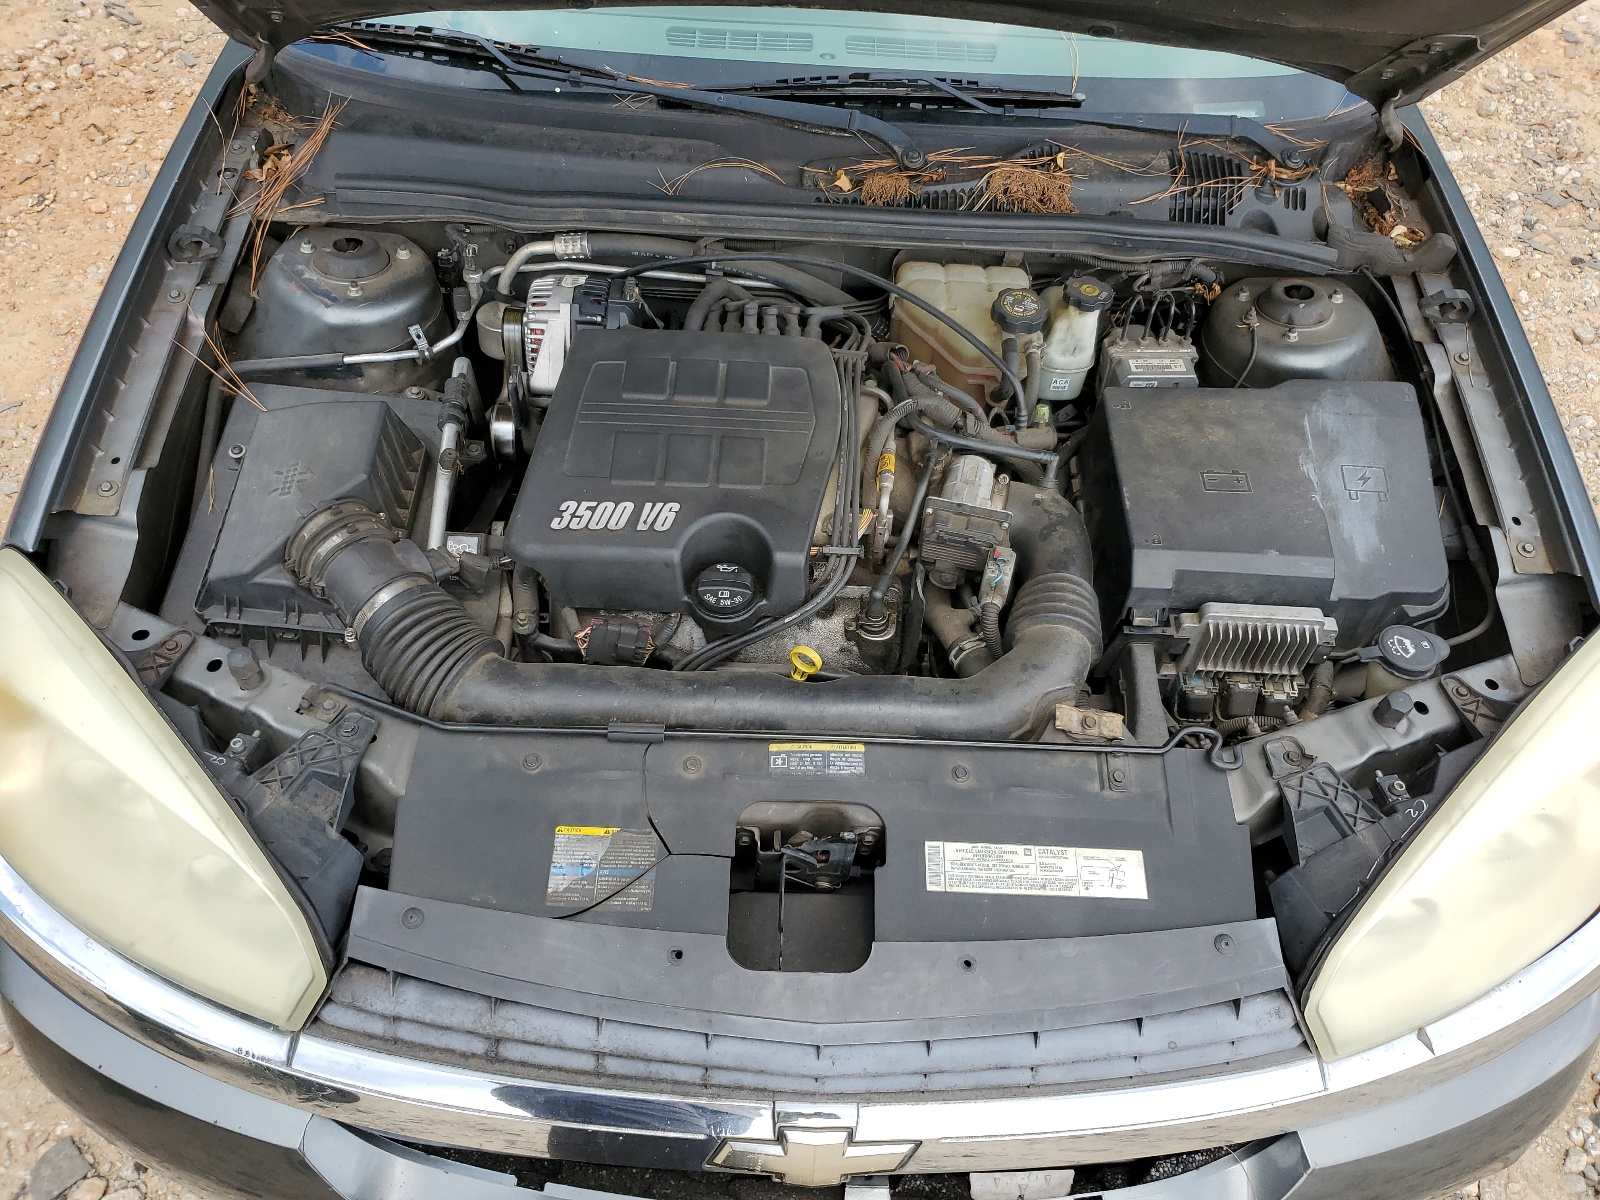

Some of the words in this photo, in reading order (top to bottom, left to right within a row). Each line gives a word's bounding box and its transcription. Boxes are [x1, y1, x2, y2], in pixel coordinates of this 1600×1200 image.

[550, 500, 635, 531] 3500
[636, 502, 681, 532] V6
[704, 593, 718, 604] SAE
[719, 595, 743, 606] 5W-30
[1037, 848, 1068, 856] CATALYST
